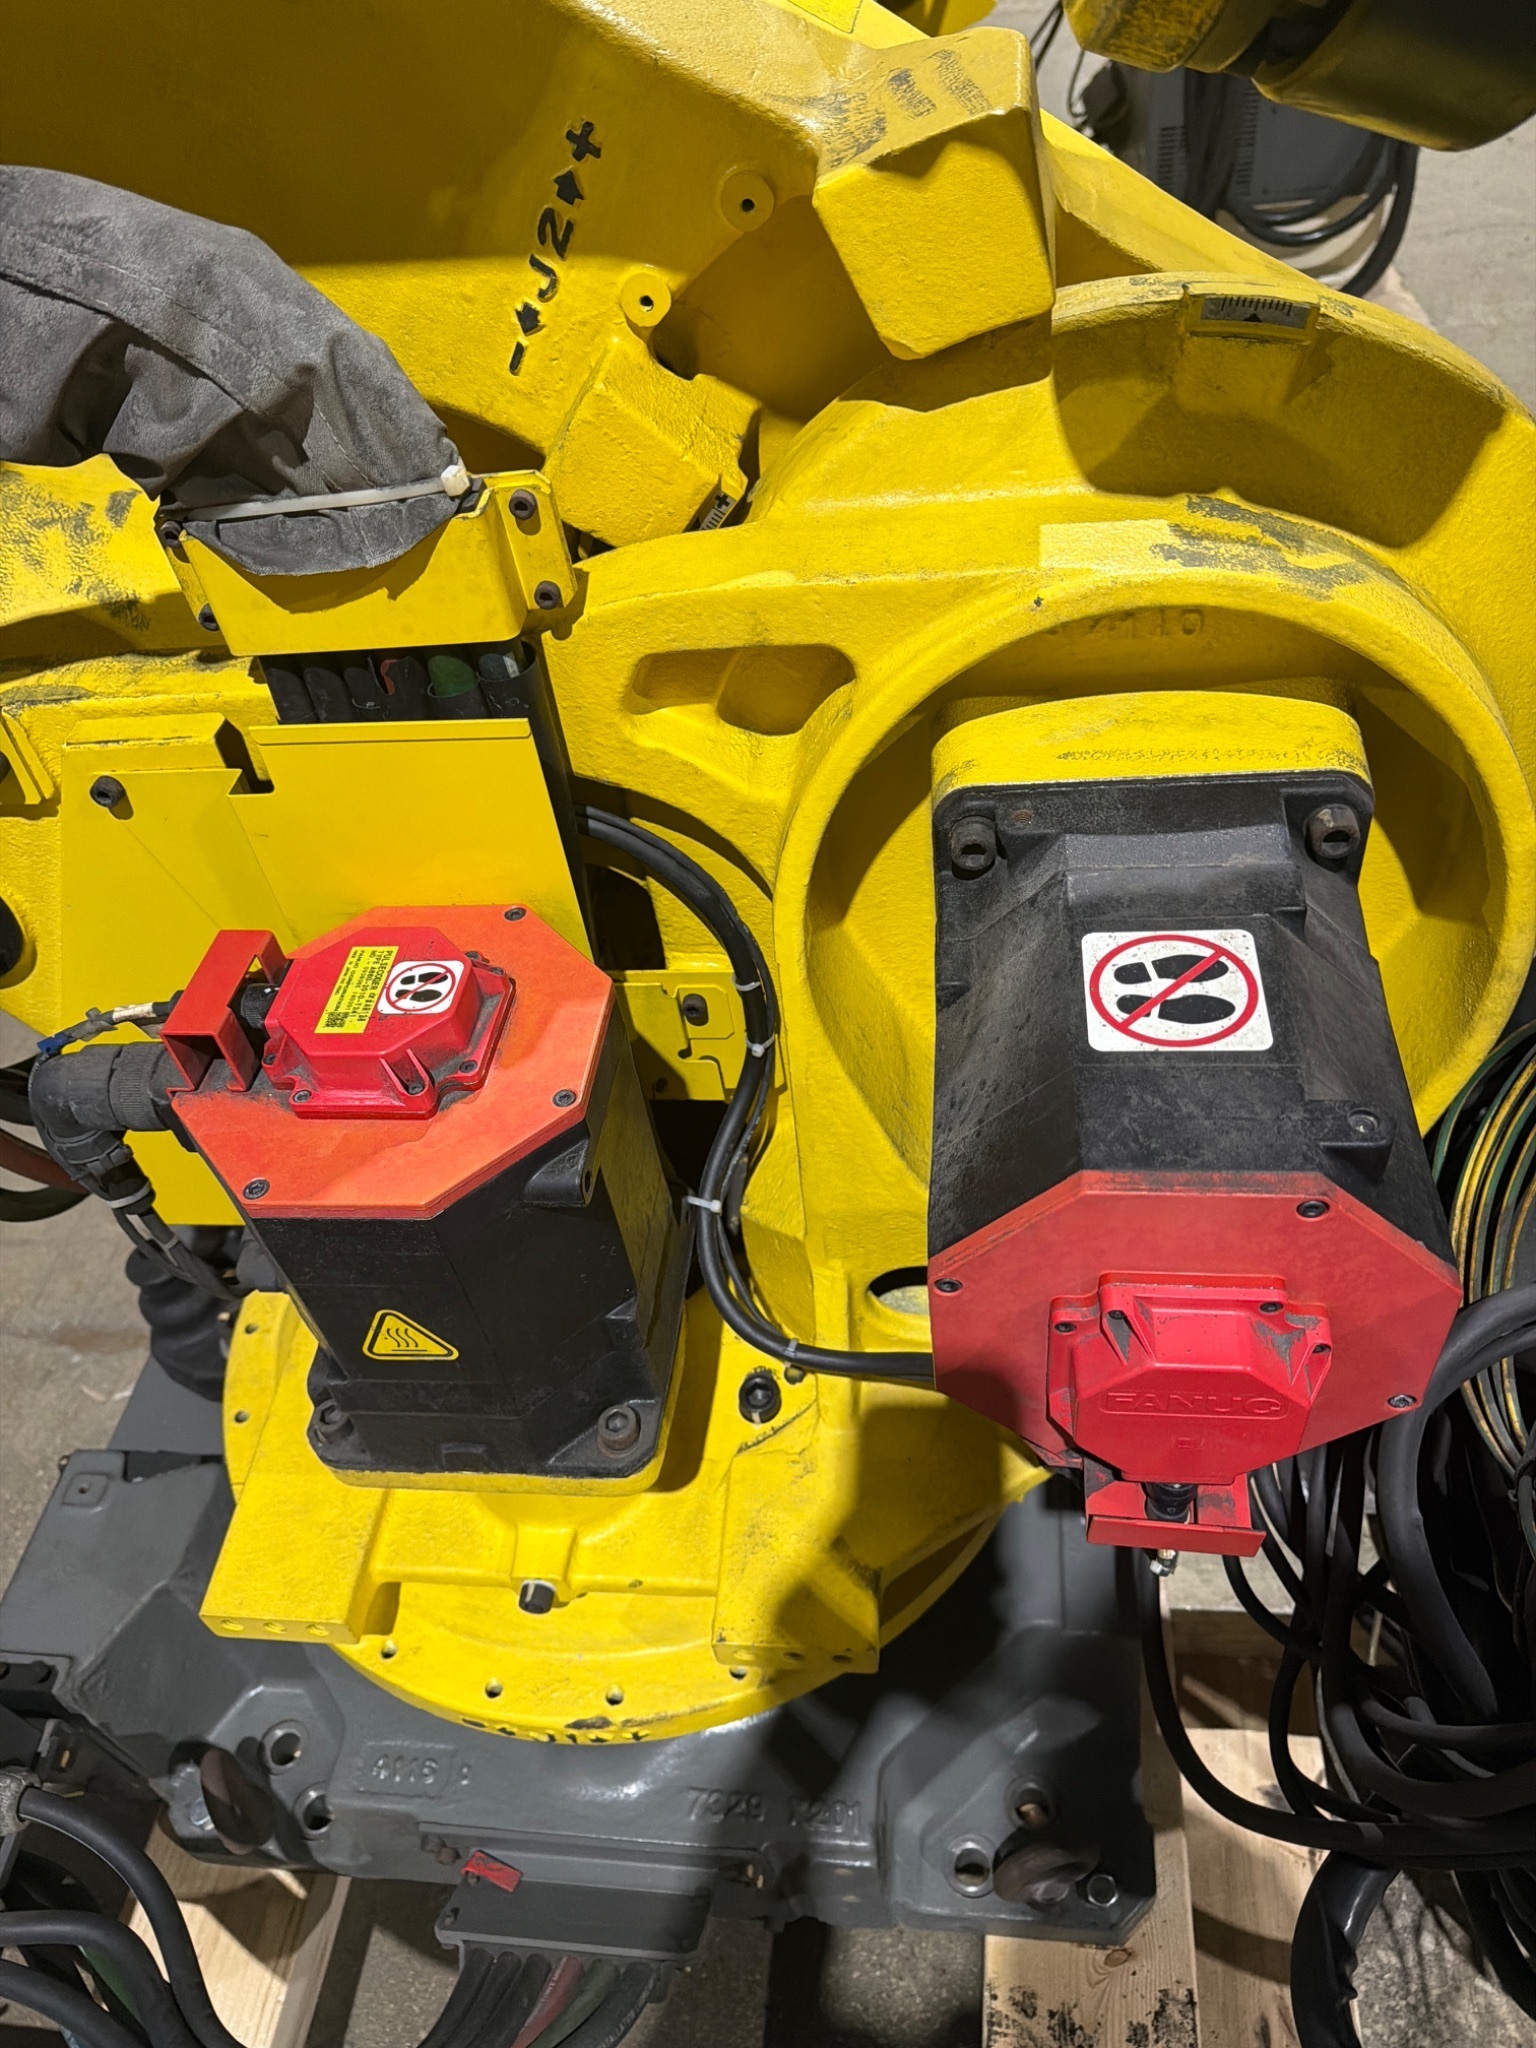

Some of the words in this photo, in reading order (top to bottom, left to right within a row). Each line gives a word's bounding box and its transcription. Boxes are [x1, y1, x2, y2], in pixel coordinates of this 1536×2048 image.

[527, 206, 575, 302] J2
[372, 950, 384, 964] TYPE
[1106, 1390, 1282, 1415] FANUC
